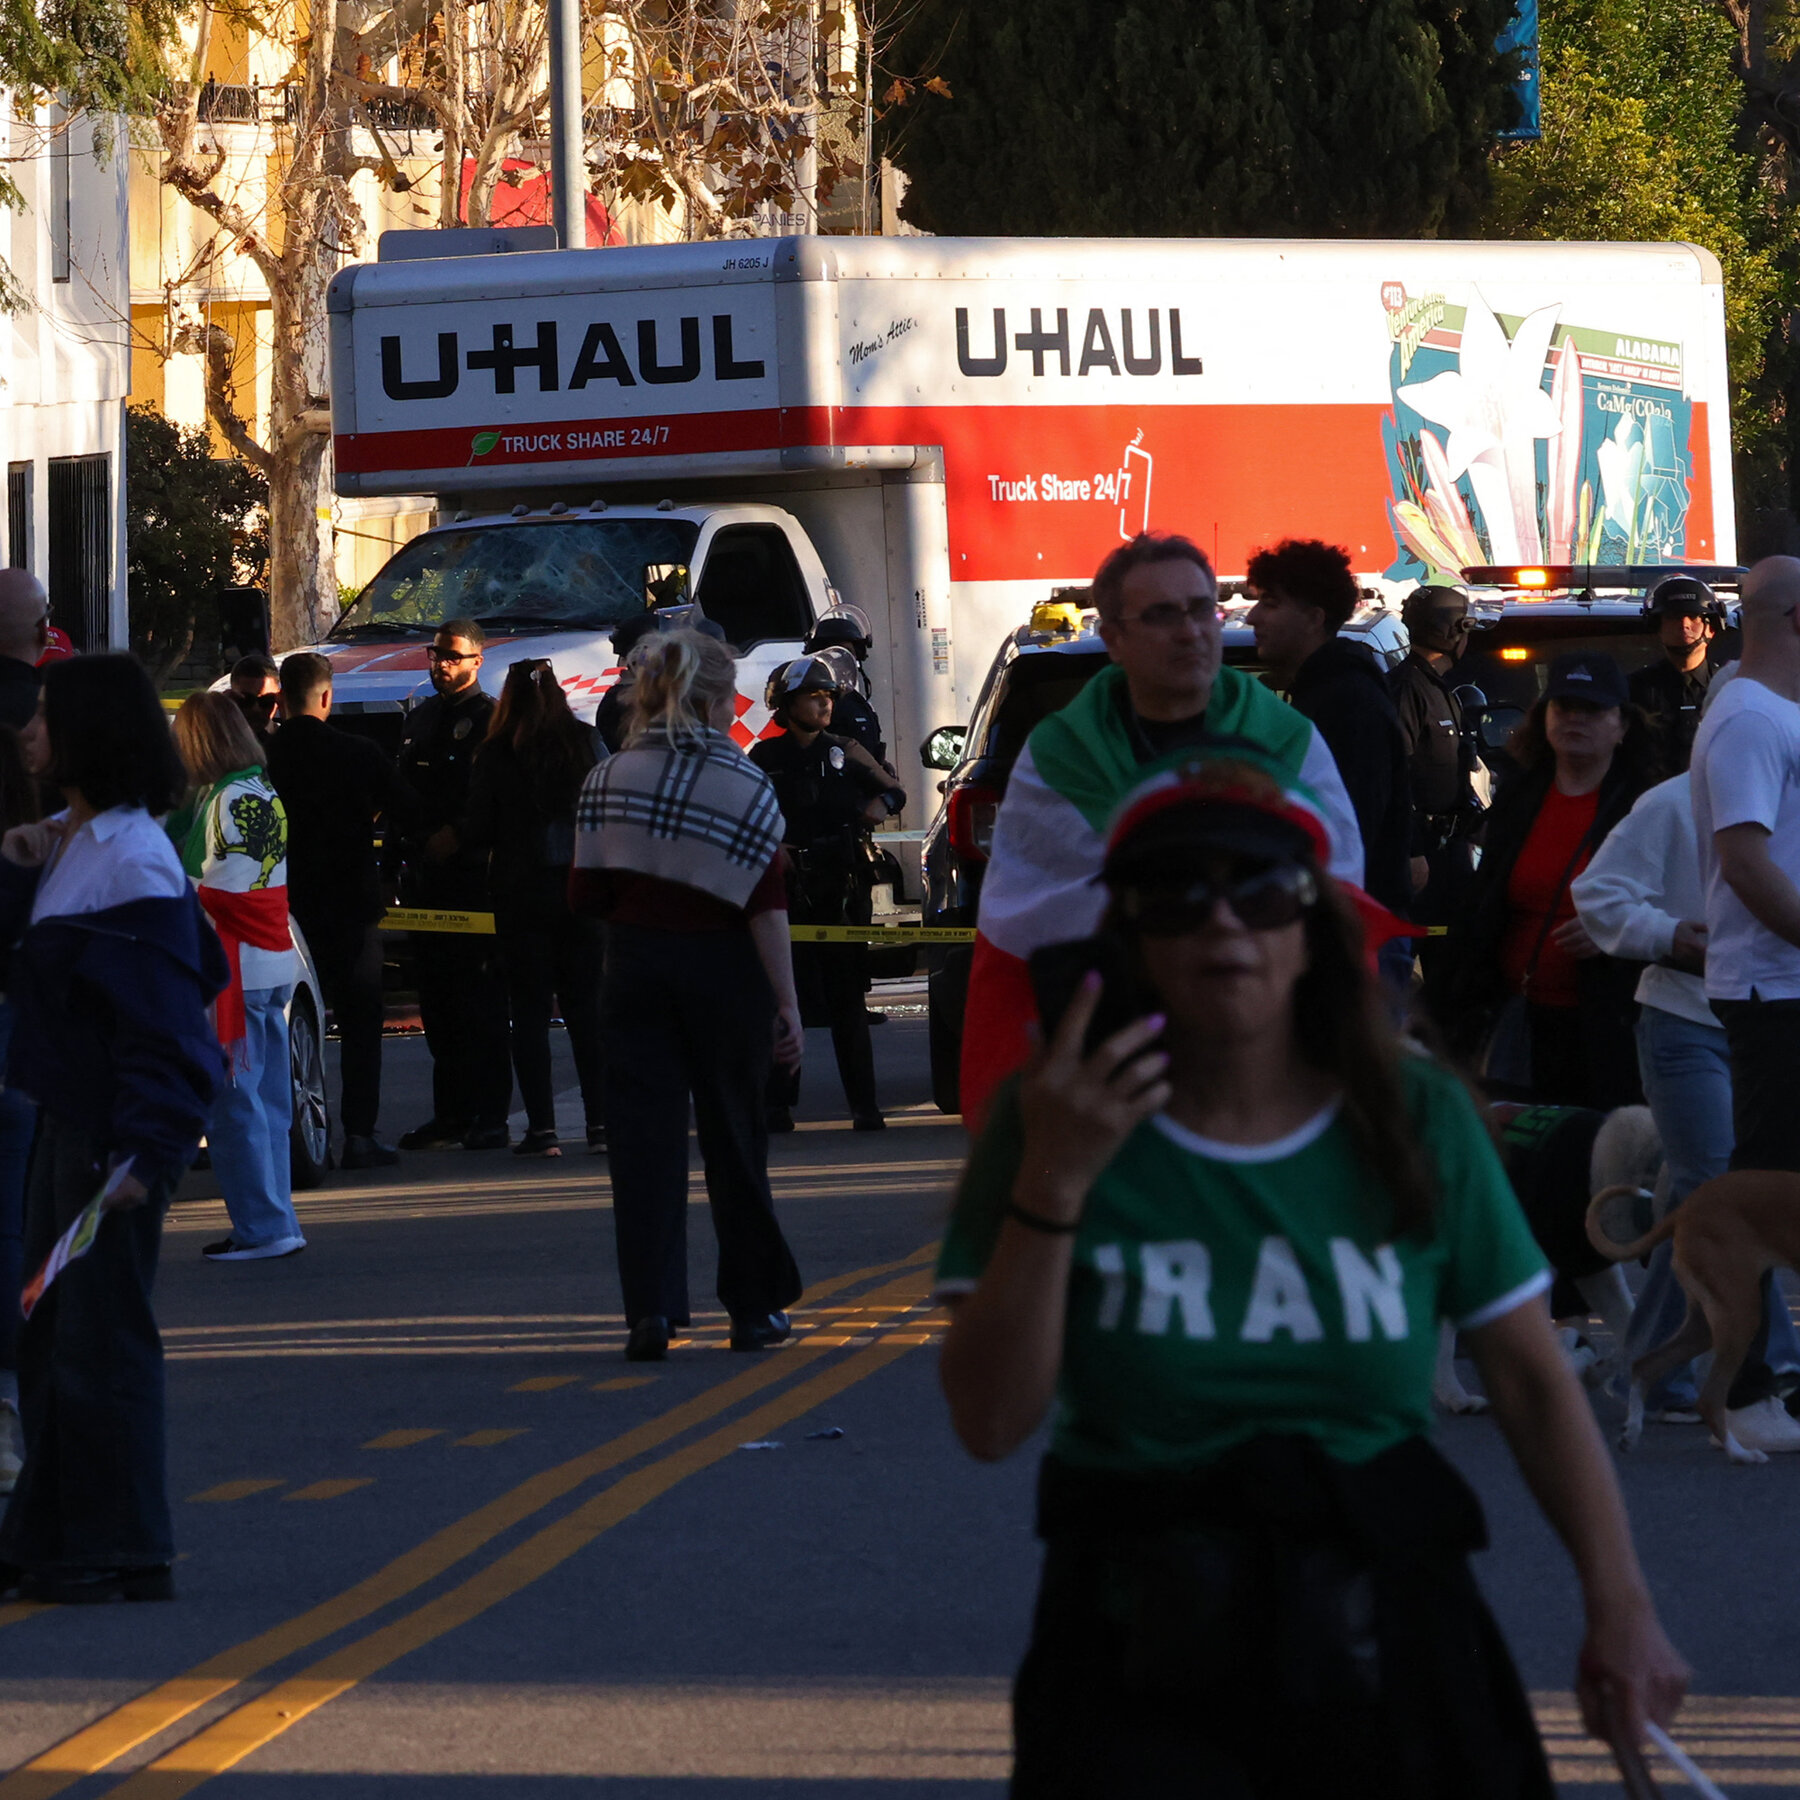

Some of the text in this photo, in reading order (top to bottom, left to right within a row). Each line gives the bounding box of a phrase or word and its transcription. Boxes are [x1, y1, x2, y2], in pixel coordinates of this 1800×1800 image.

[722, 256, 769, 270] JH 6205 J
[381, 314, 765, 401] U-HAUL
[849, 317, 913, 365] Mom's Attic
[955, 307, 1203, 377] U-HAUL
[1615, 338, 1680, 366] ALABAMA
[502, 425, 670, 453] TRUCK SHARE 24/7
[987, 467, 1132, 506] Truck Share 24/7
[1093, 1236, 1410, 1343] IRAN
